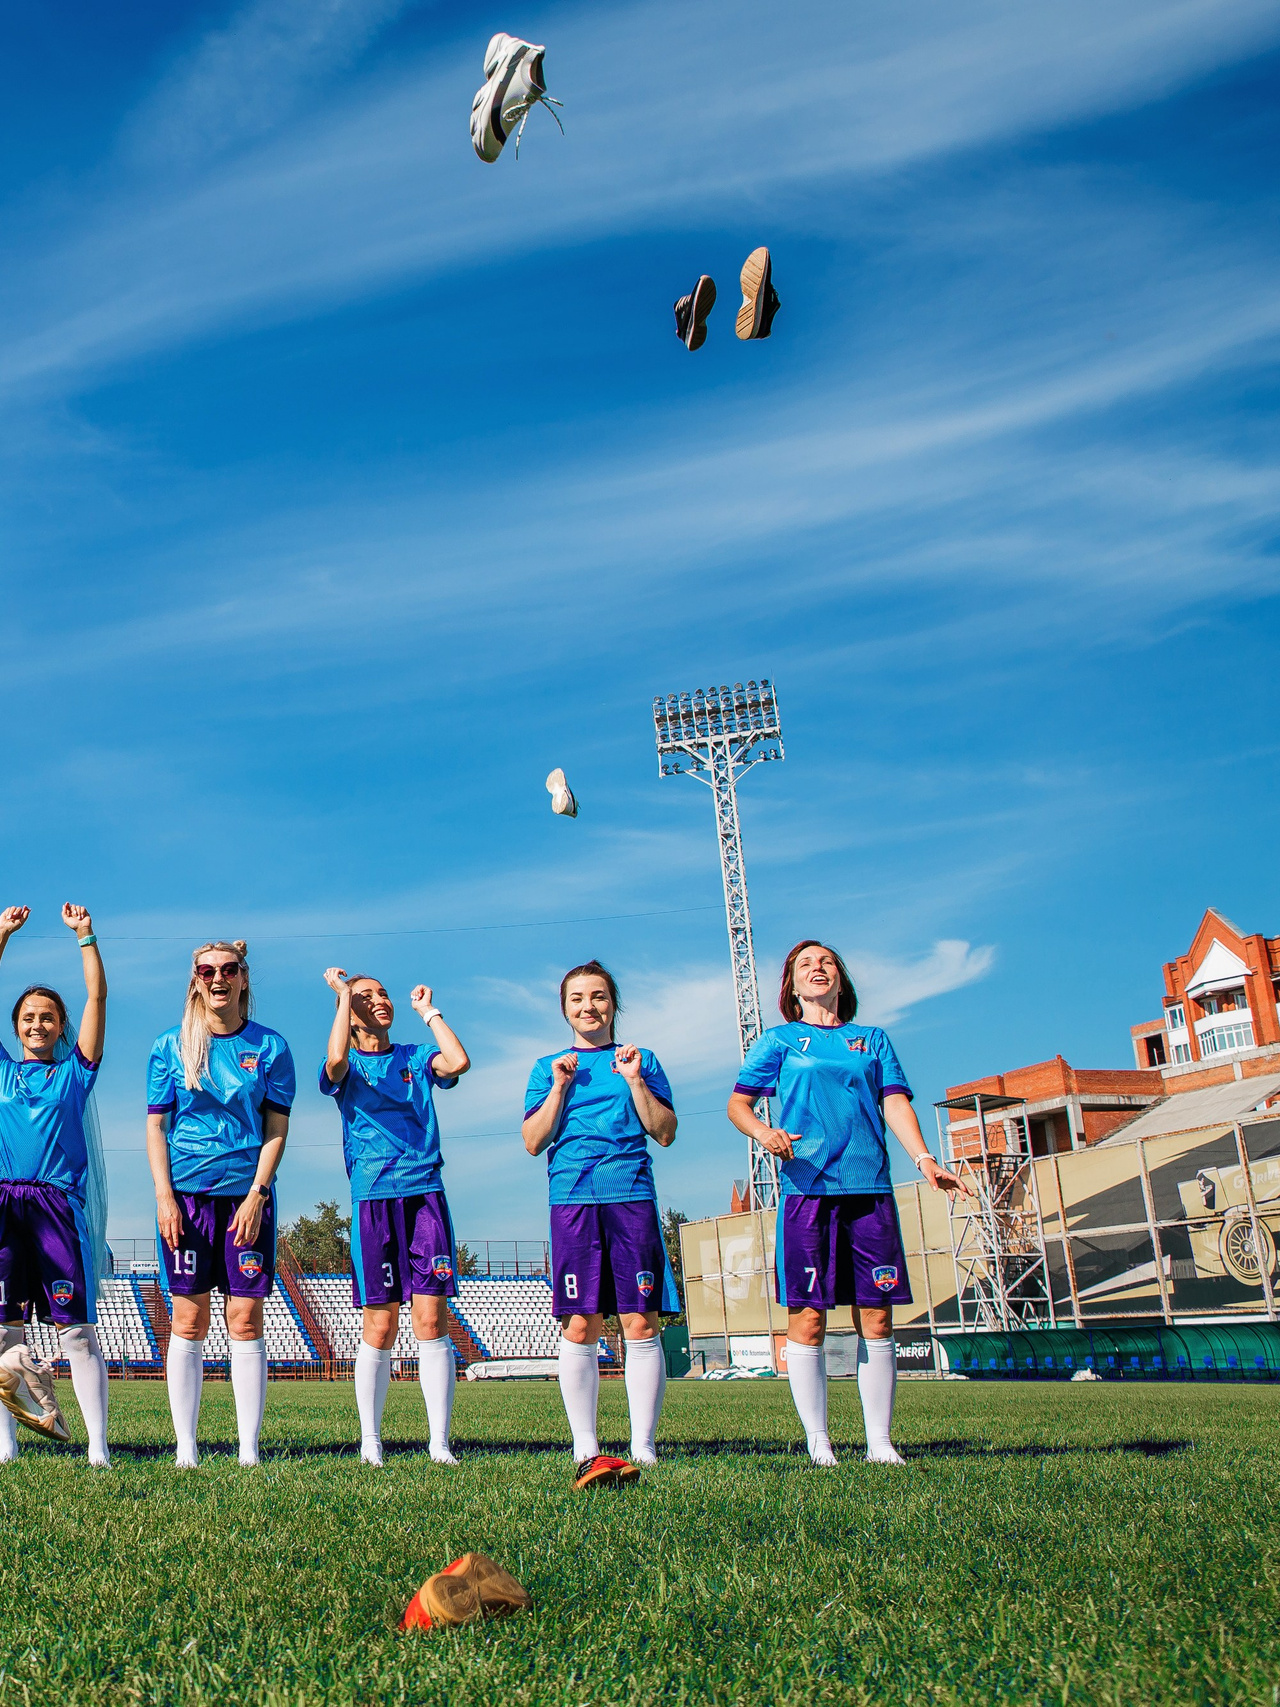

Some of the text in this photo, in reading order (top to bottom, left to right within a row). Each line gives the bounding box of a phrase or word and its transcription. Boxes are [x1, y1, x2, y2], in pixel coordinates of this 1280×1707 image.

[798, 1037, 811, 1052] 7
[173, 1249, 197, 1275] 19
[381, 1262, 394, 1288] 3
[564, 1273, 578, 1299] 8
[804, 1267, 817, 1292] 7
[895, 1342, 931, 1359] ENERGY
